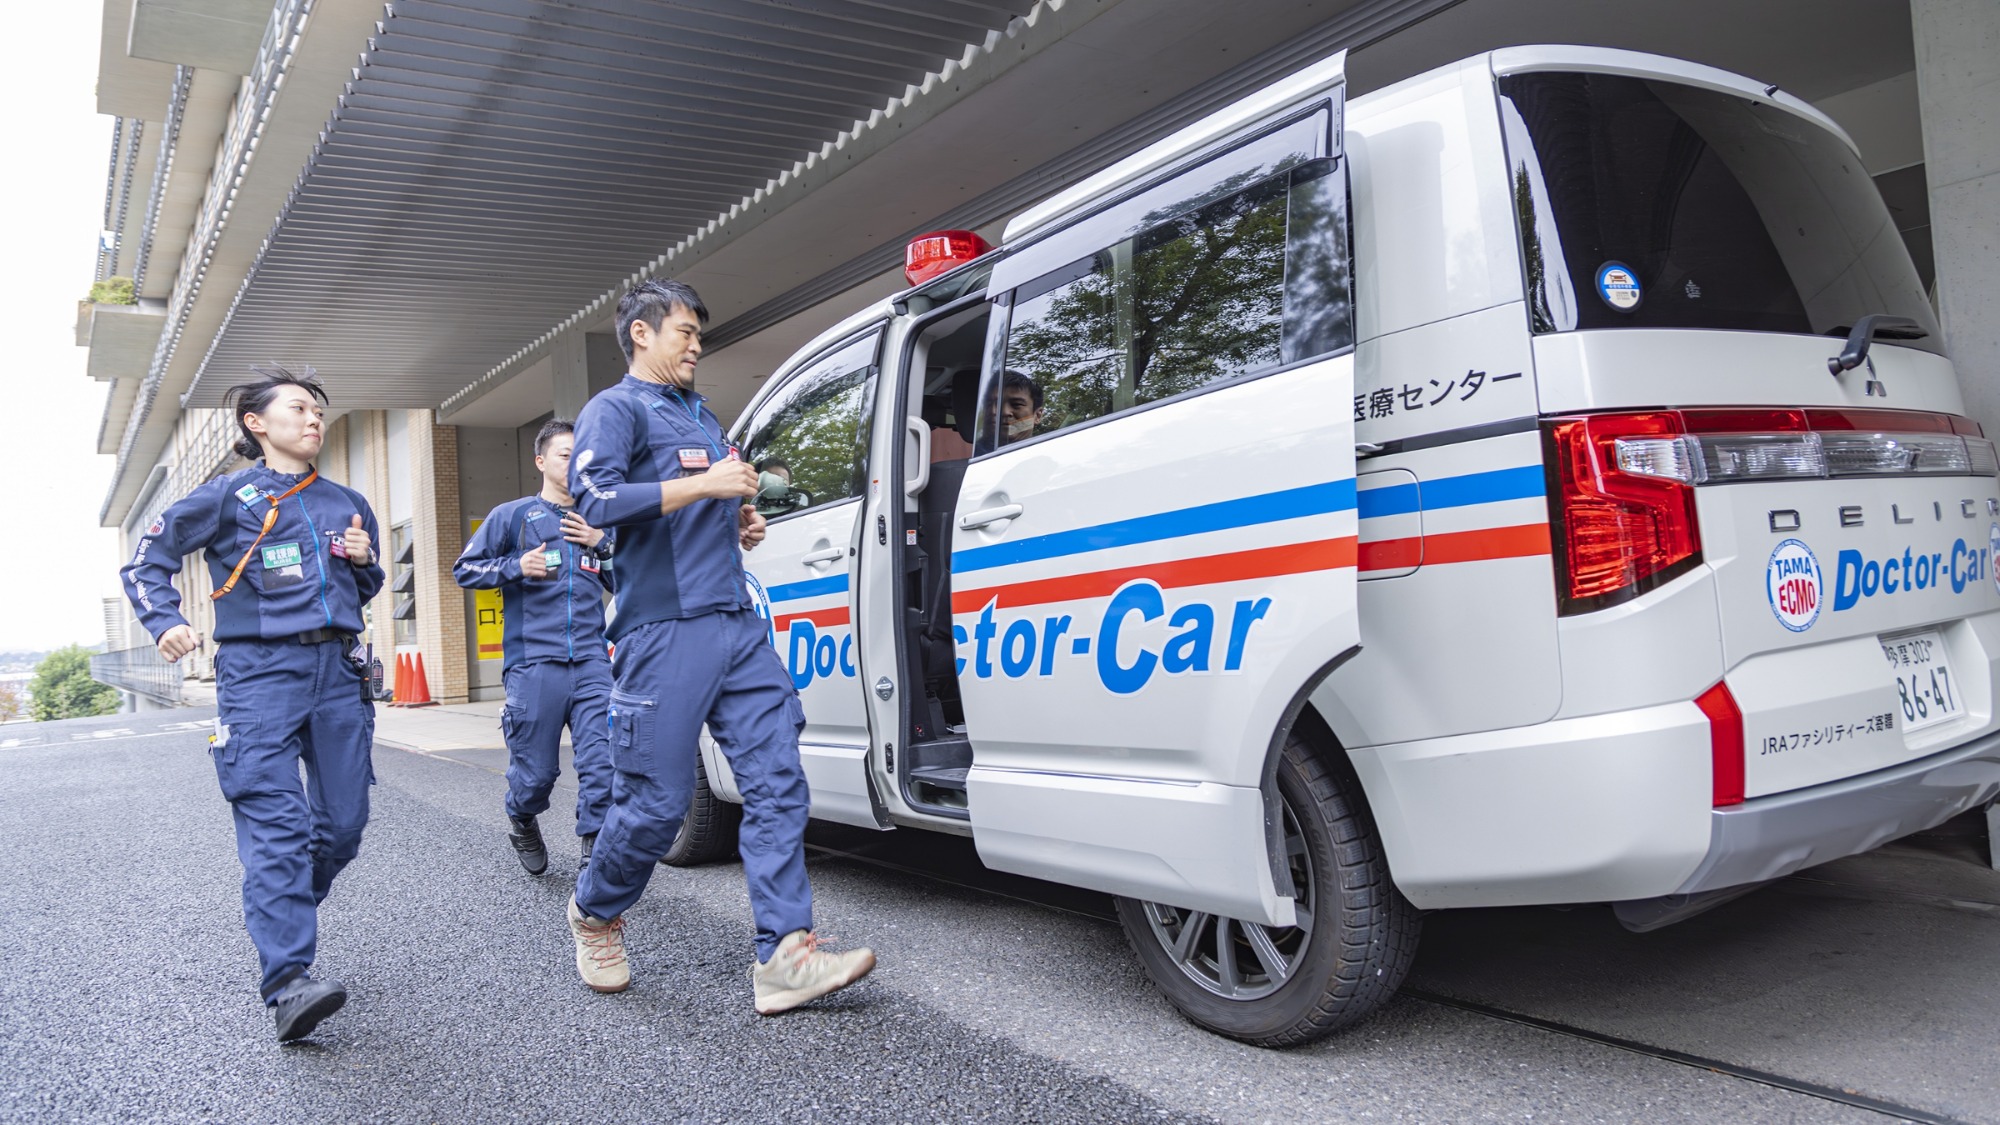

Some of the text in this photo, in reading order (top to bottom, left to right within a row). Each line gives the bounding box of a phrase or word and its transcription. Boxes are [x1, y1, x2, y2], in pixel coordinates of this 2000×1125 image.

[1775, 556, 1814, 581] TAMA
[1833, 538, 1987, 612] Doctor-Car
[1778, 578, 1816, 615] ECMO
